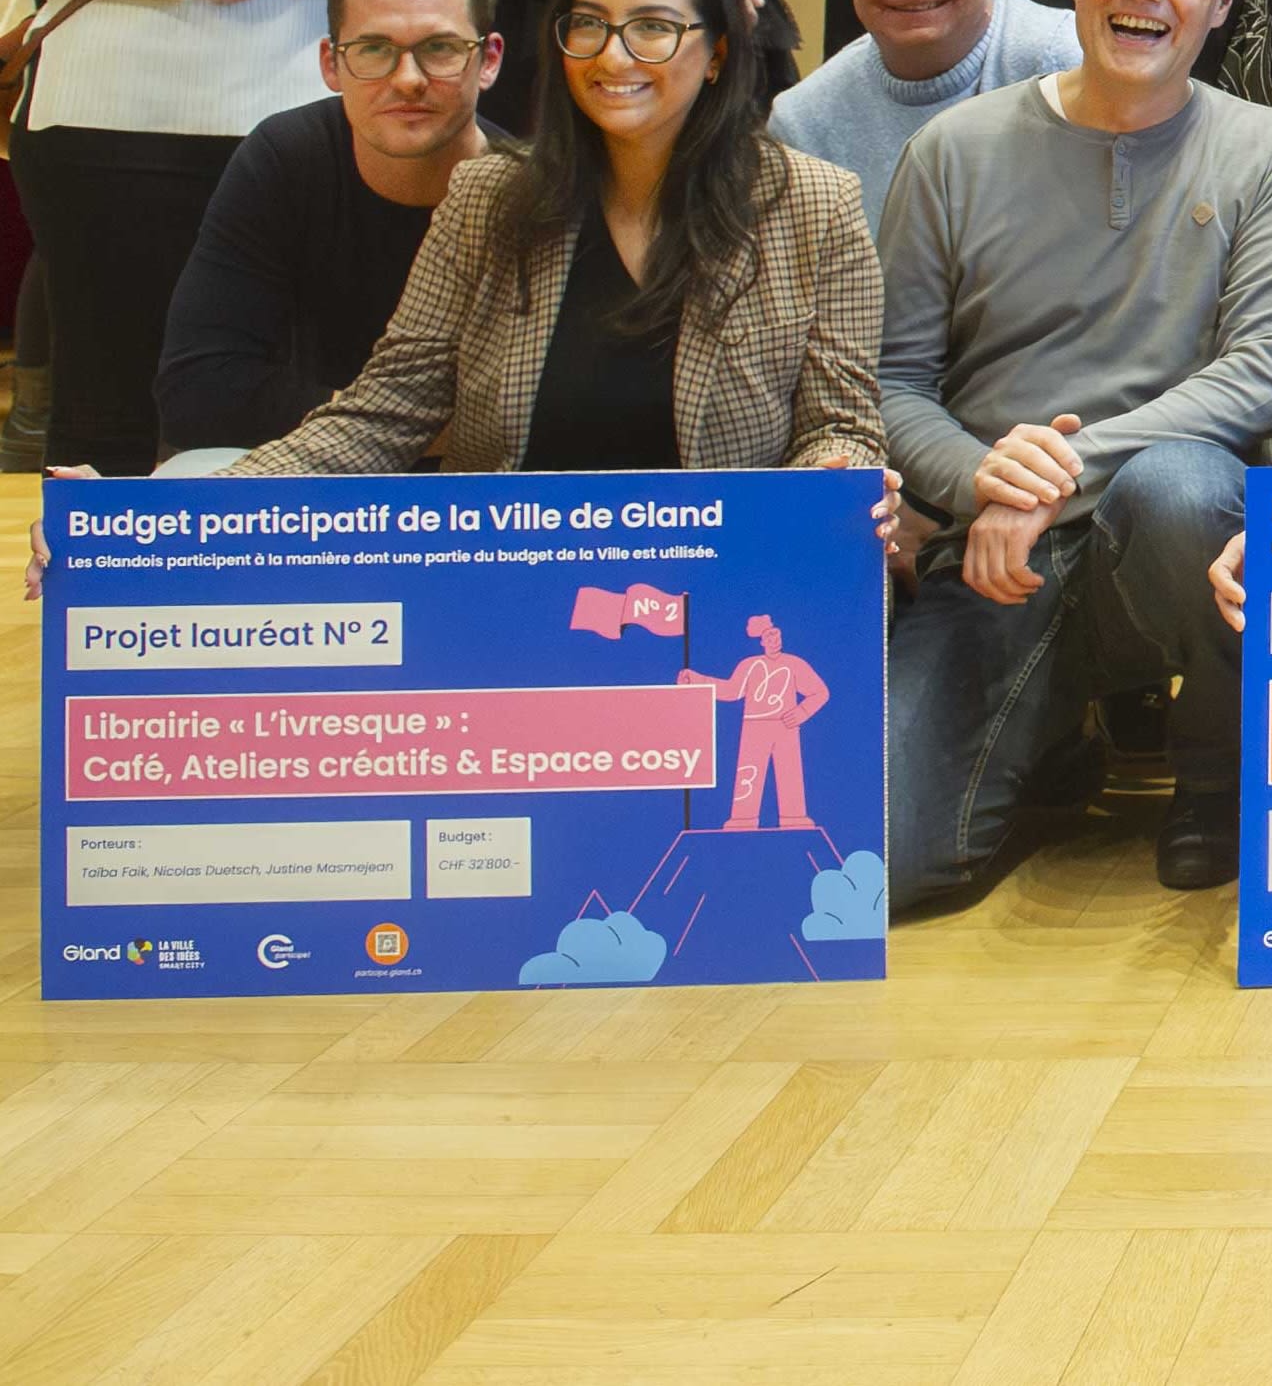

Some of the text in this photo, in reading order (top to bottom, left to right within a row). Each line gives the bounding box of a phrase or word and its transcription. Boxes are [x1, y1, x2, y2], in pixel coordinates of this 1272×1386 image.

[70, 500, 722, 544] Budget participatif de la Ville de Gland
[68, 545, 718, 570] Les Glandois participent à la manière dont une partie du budget de la Ville est utilisée.
[664, 602, 678, 622] 2
[86, 622, 181, 655] Projet
[192, 620, 313, 647] lauréat
[372, 620, 388, 644] 2
[85, 711, 220, 739] Librairie
[84, 748, 702, 784] Café, Ateliers créatifs & Espace cosy
[154, 866, 201, 876] Nicolas
[266, 864, 312, 874] Justine
[439, 860, 464, 870] CHF
[64, 945, 120, 960] Gland
